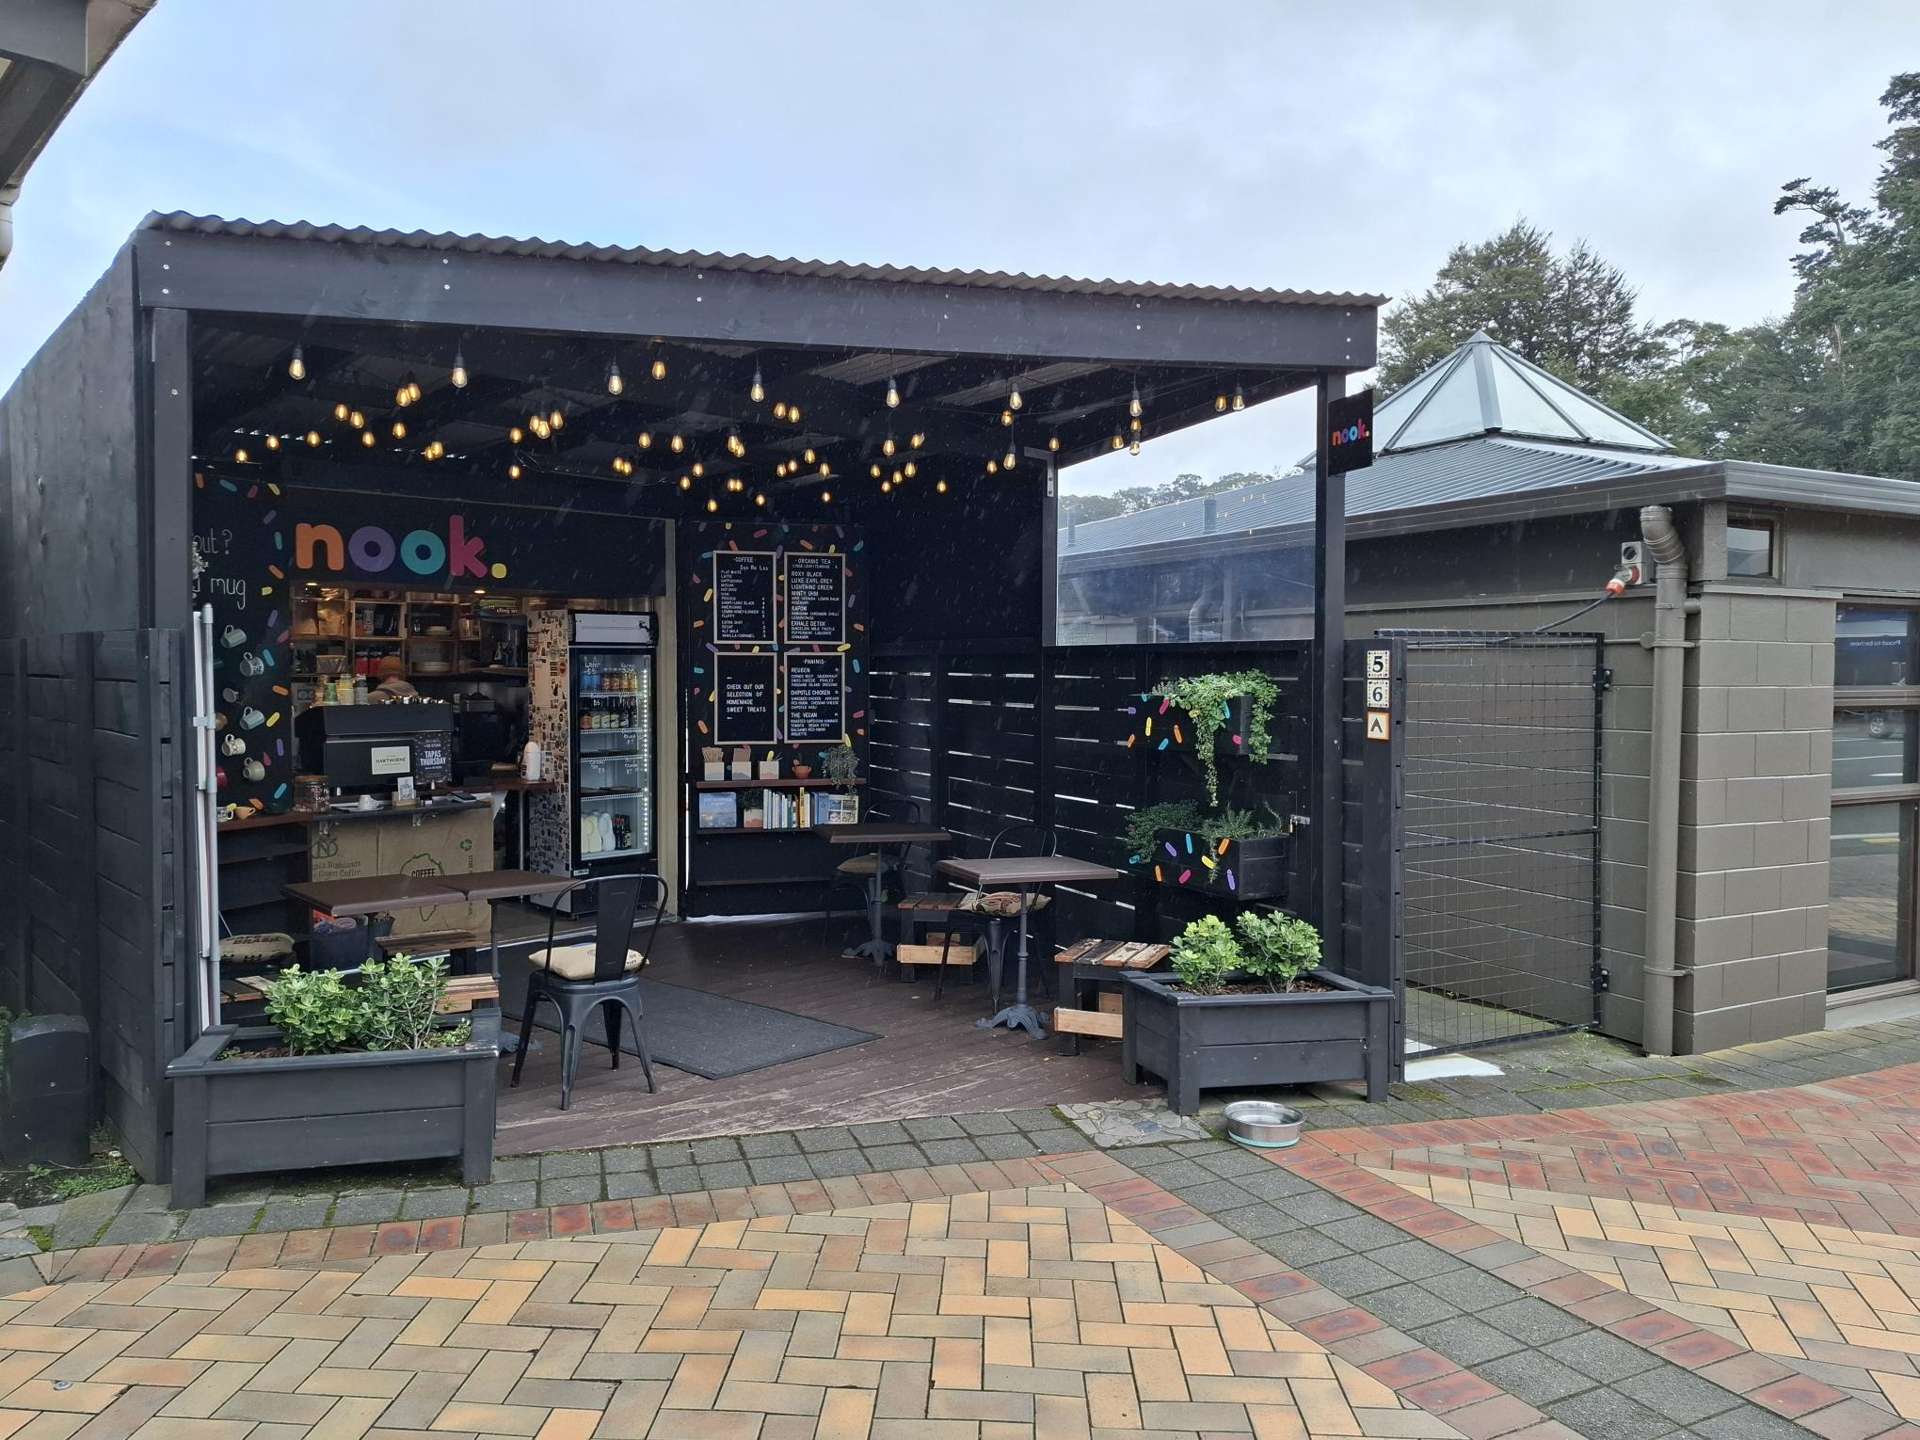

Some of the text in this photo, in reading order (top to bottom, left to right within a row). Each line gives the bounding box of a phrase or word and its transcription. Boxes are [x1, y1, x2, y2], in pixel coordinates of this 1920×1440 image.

[1332, 418, 1369, 447] nook.
[295, 514, 507, 578] nook.
[211, 578, 245, 610] mug
[1370, 655, 1384, 733] 5 6 A
[424, 750, 442, 759] TAPAS
